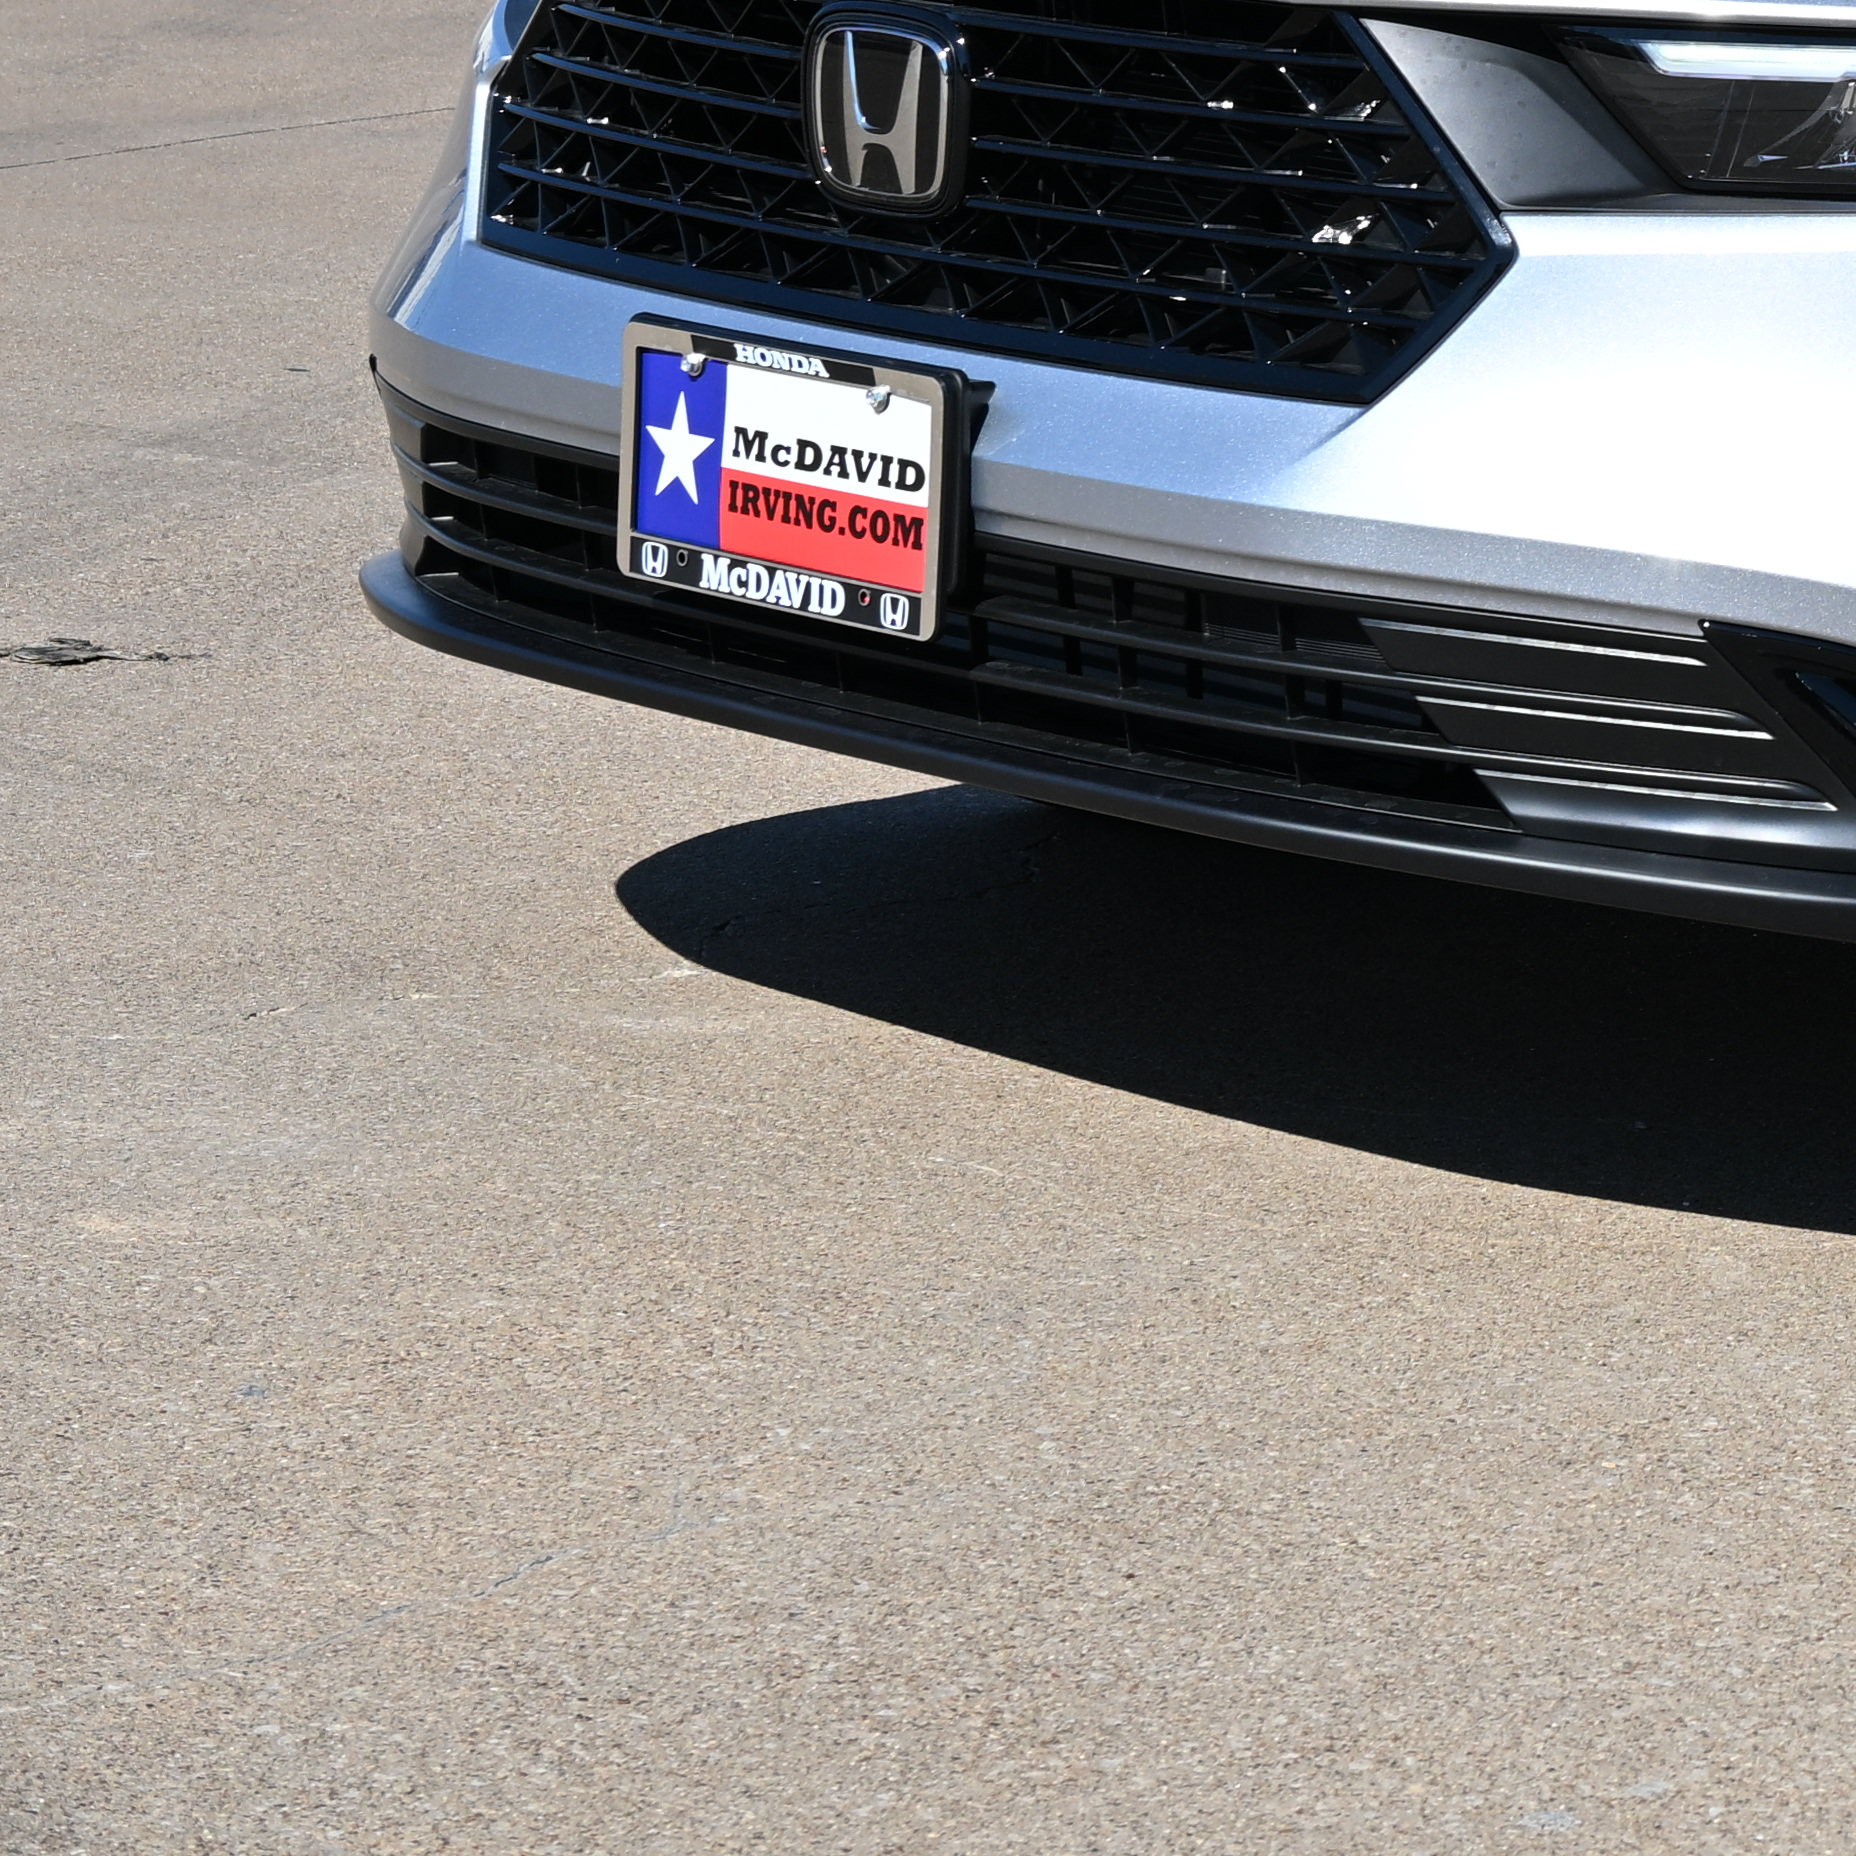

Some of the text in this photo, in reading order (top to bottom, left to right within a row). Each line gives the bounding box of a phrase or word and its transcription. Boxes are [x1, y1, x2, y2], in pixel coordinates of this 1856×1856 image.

[734, 343, 830, 378] HONDA
[732, 425, 926, 492] McDAVID
[728, 480, 925, 550] IRVING.COM
[699, 553, 846, 617] McDAVID
